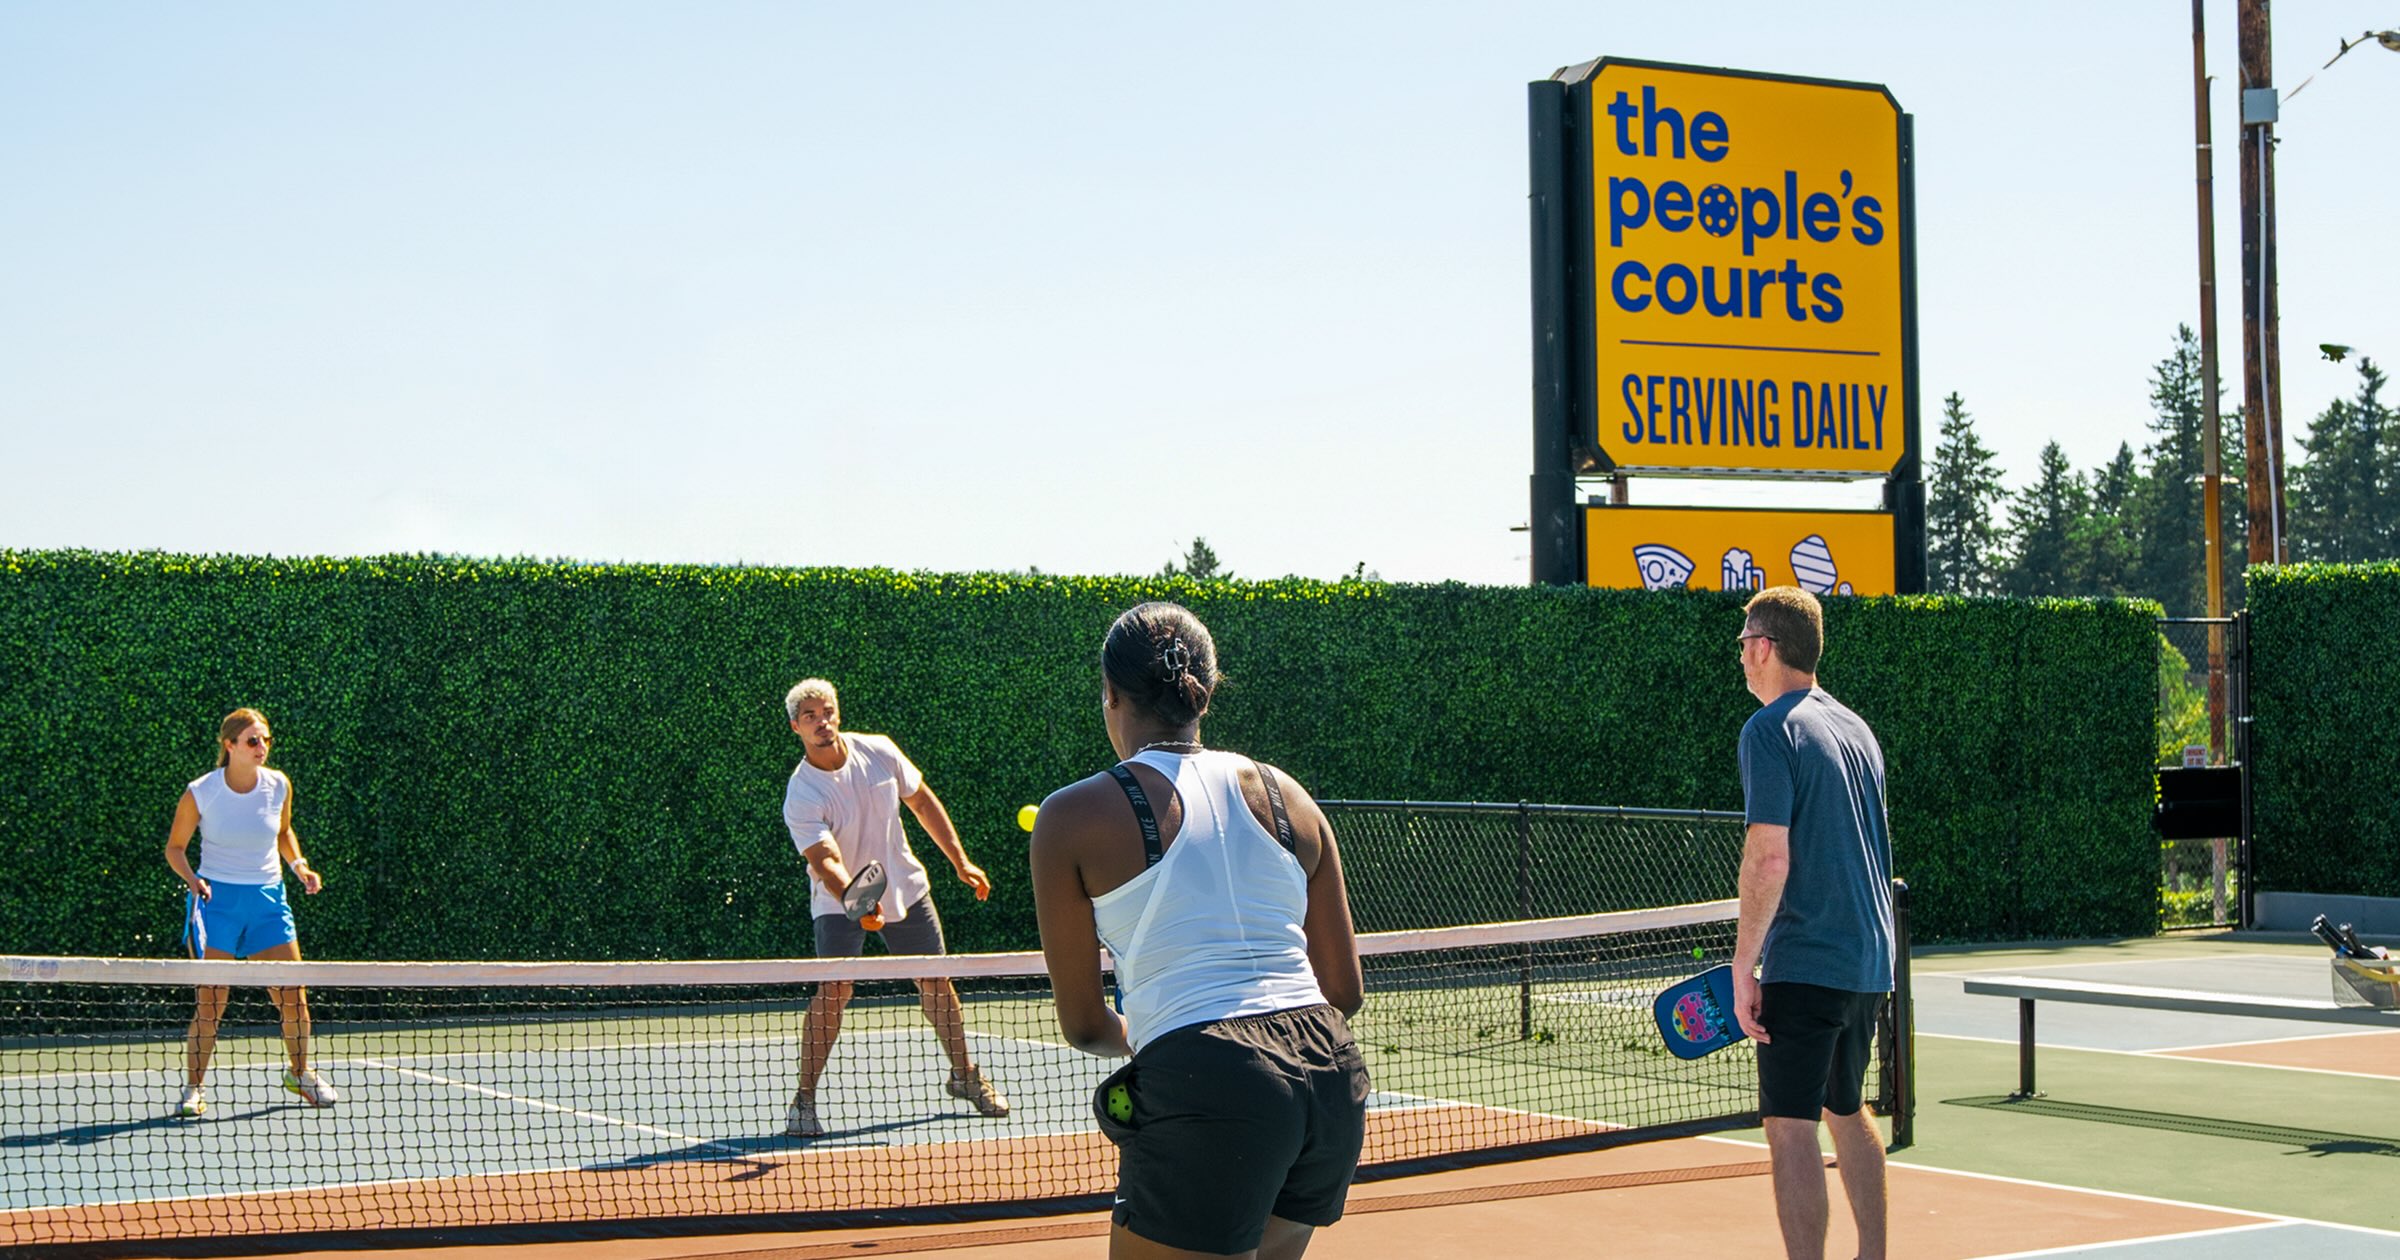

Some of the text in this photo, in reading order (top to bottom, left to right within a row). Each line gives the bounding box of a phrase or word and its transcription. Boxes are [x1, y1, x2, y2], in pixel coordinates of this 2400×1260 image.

[1607, 86, 1729, 163] the
[1608, 169, 1884, 257] people's
[1611, 259, 1844, 323] courts
[1622, 374, 1888, 450] SERVING DAILY
[1125, 786, 1148, 806] NIKE
[1267, 784, 1284, 809] NIKE
[1140, 817, 1159, 841] NIKE
[1277, 816, 1293, 845] NIKE
